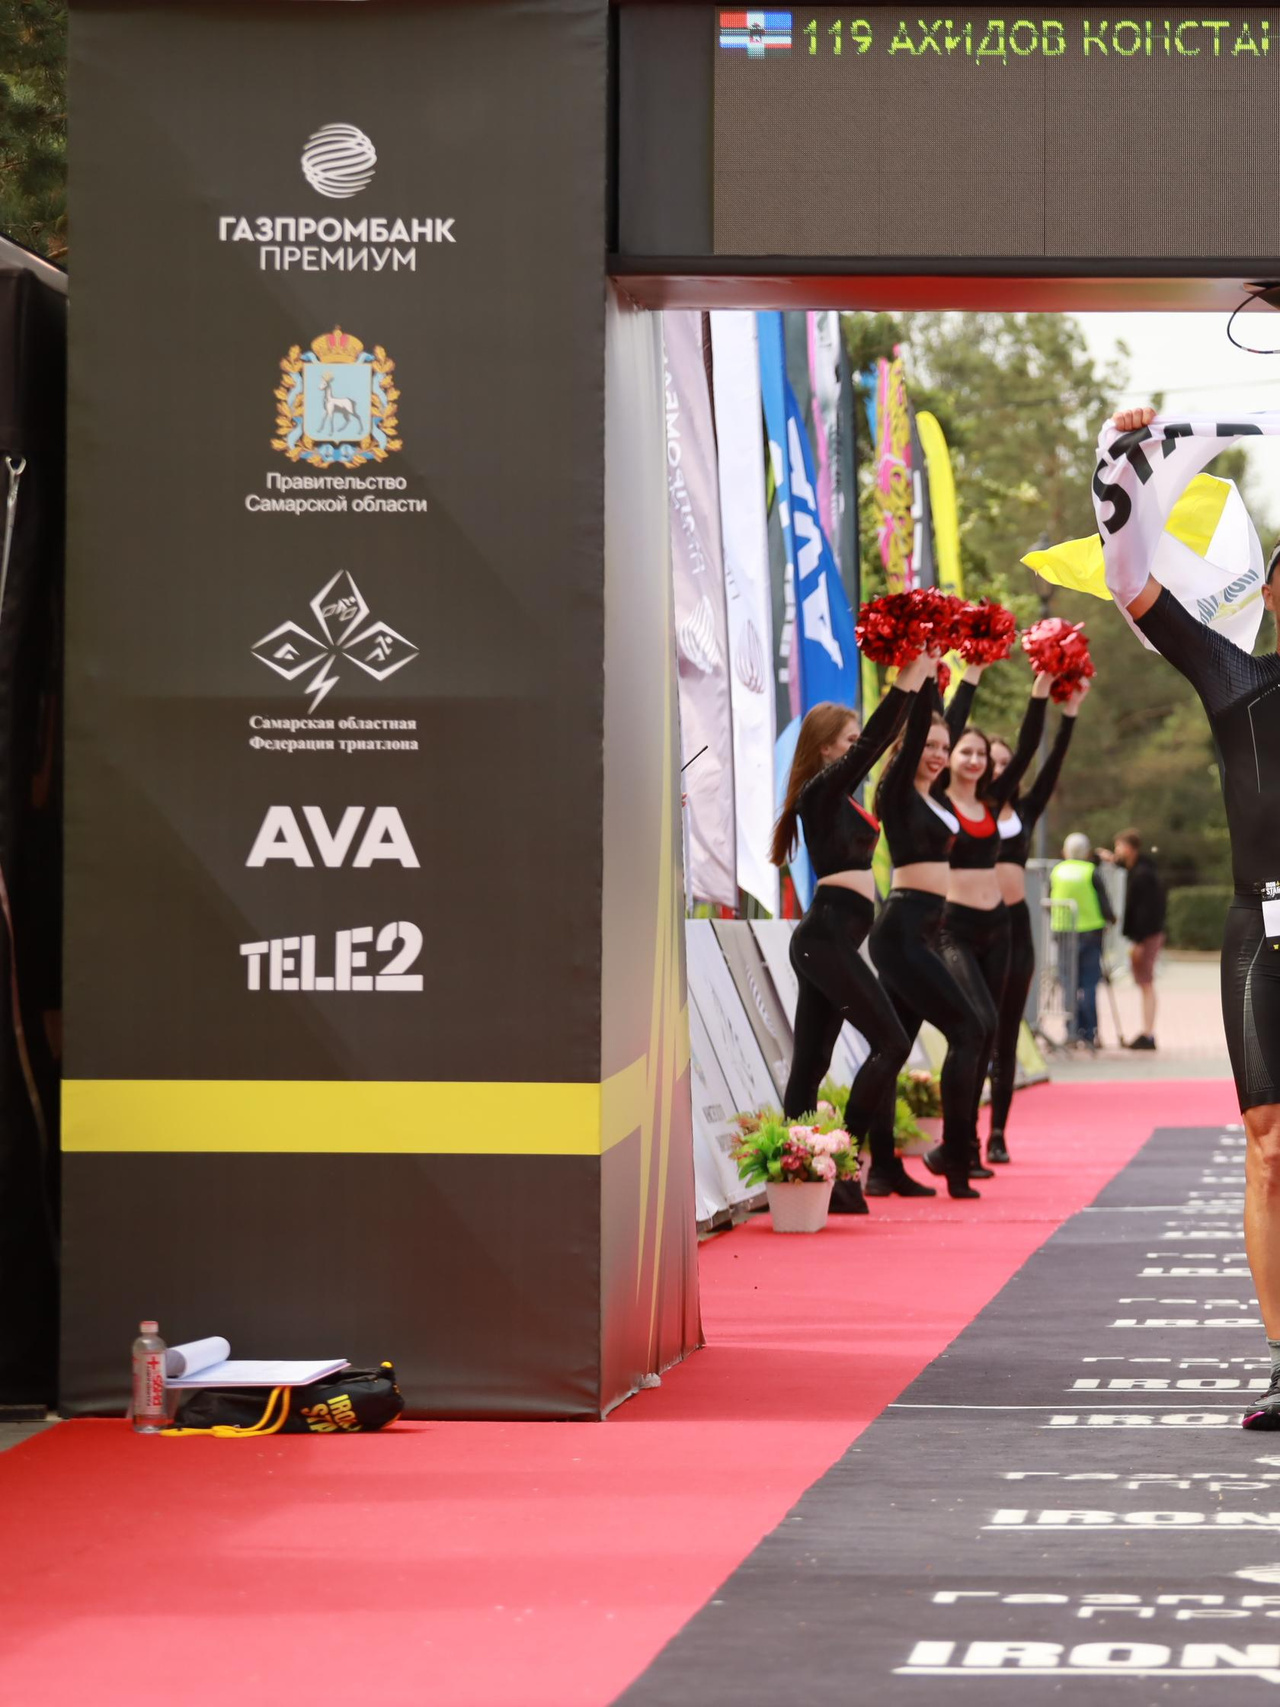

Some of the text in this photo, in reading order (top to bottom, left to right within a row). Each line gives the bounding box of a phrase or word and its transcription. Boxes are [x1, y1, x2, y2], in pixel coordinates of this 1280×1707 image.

[802, 18, 873, 56] 119
[887, 18, 1066, 65] АХИДОВ
[218, 215, 457, 244] ГАЗПРОМБАНК
[259, 246, 417, 272] ПРЕМИУМ
[266, 472, 407, 494] Правительство
[245, 494, 428, 516] Самарской области
[248, 715, 418, 733] Самарская областная
[248, 736, 420, 754] Федерация триатлона
[244, 804, 422, 869] AVA
[239, 920, 424, 992] TELE2
[1048, 1413, 1246, 1426] IRO
